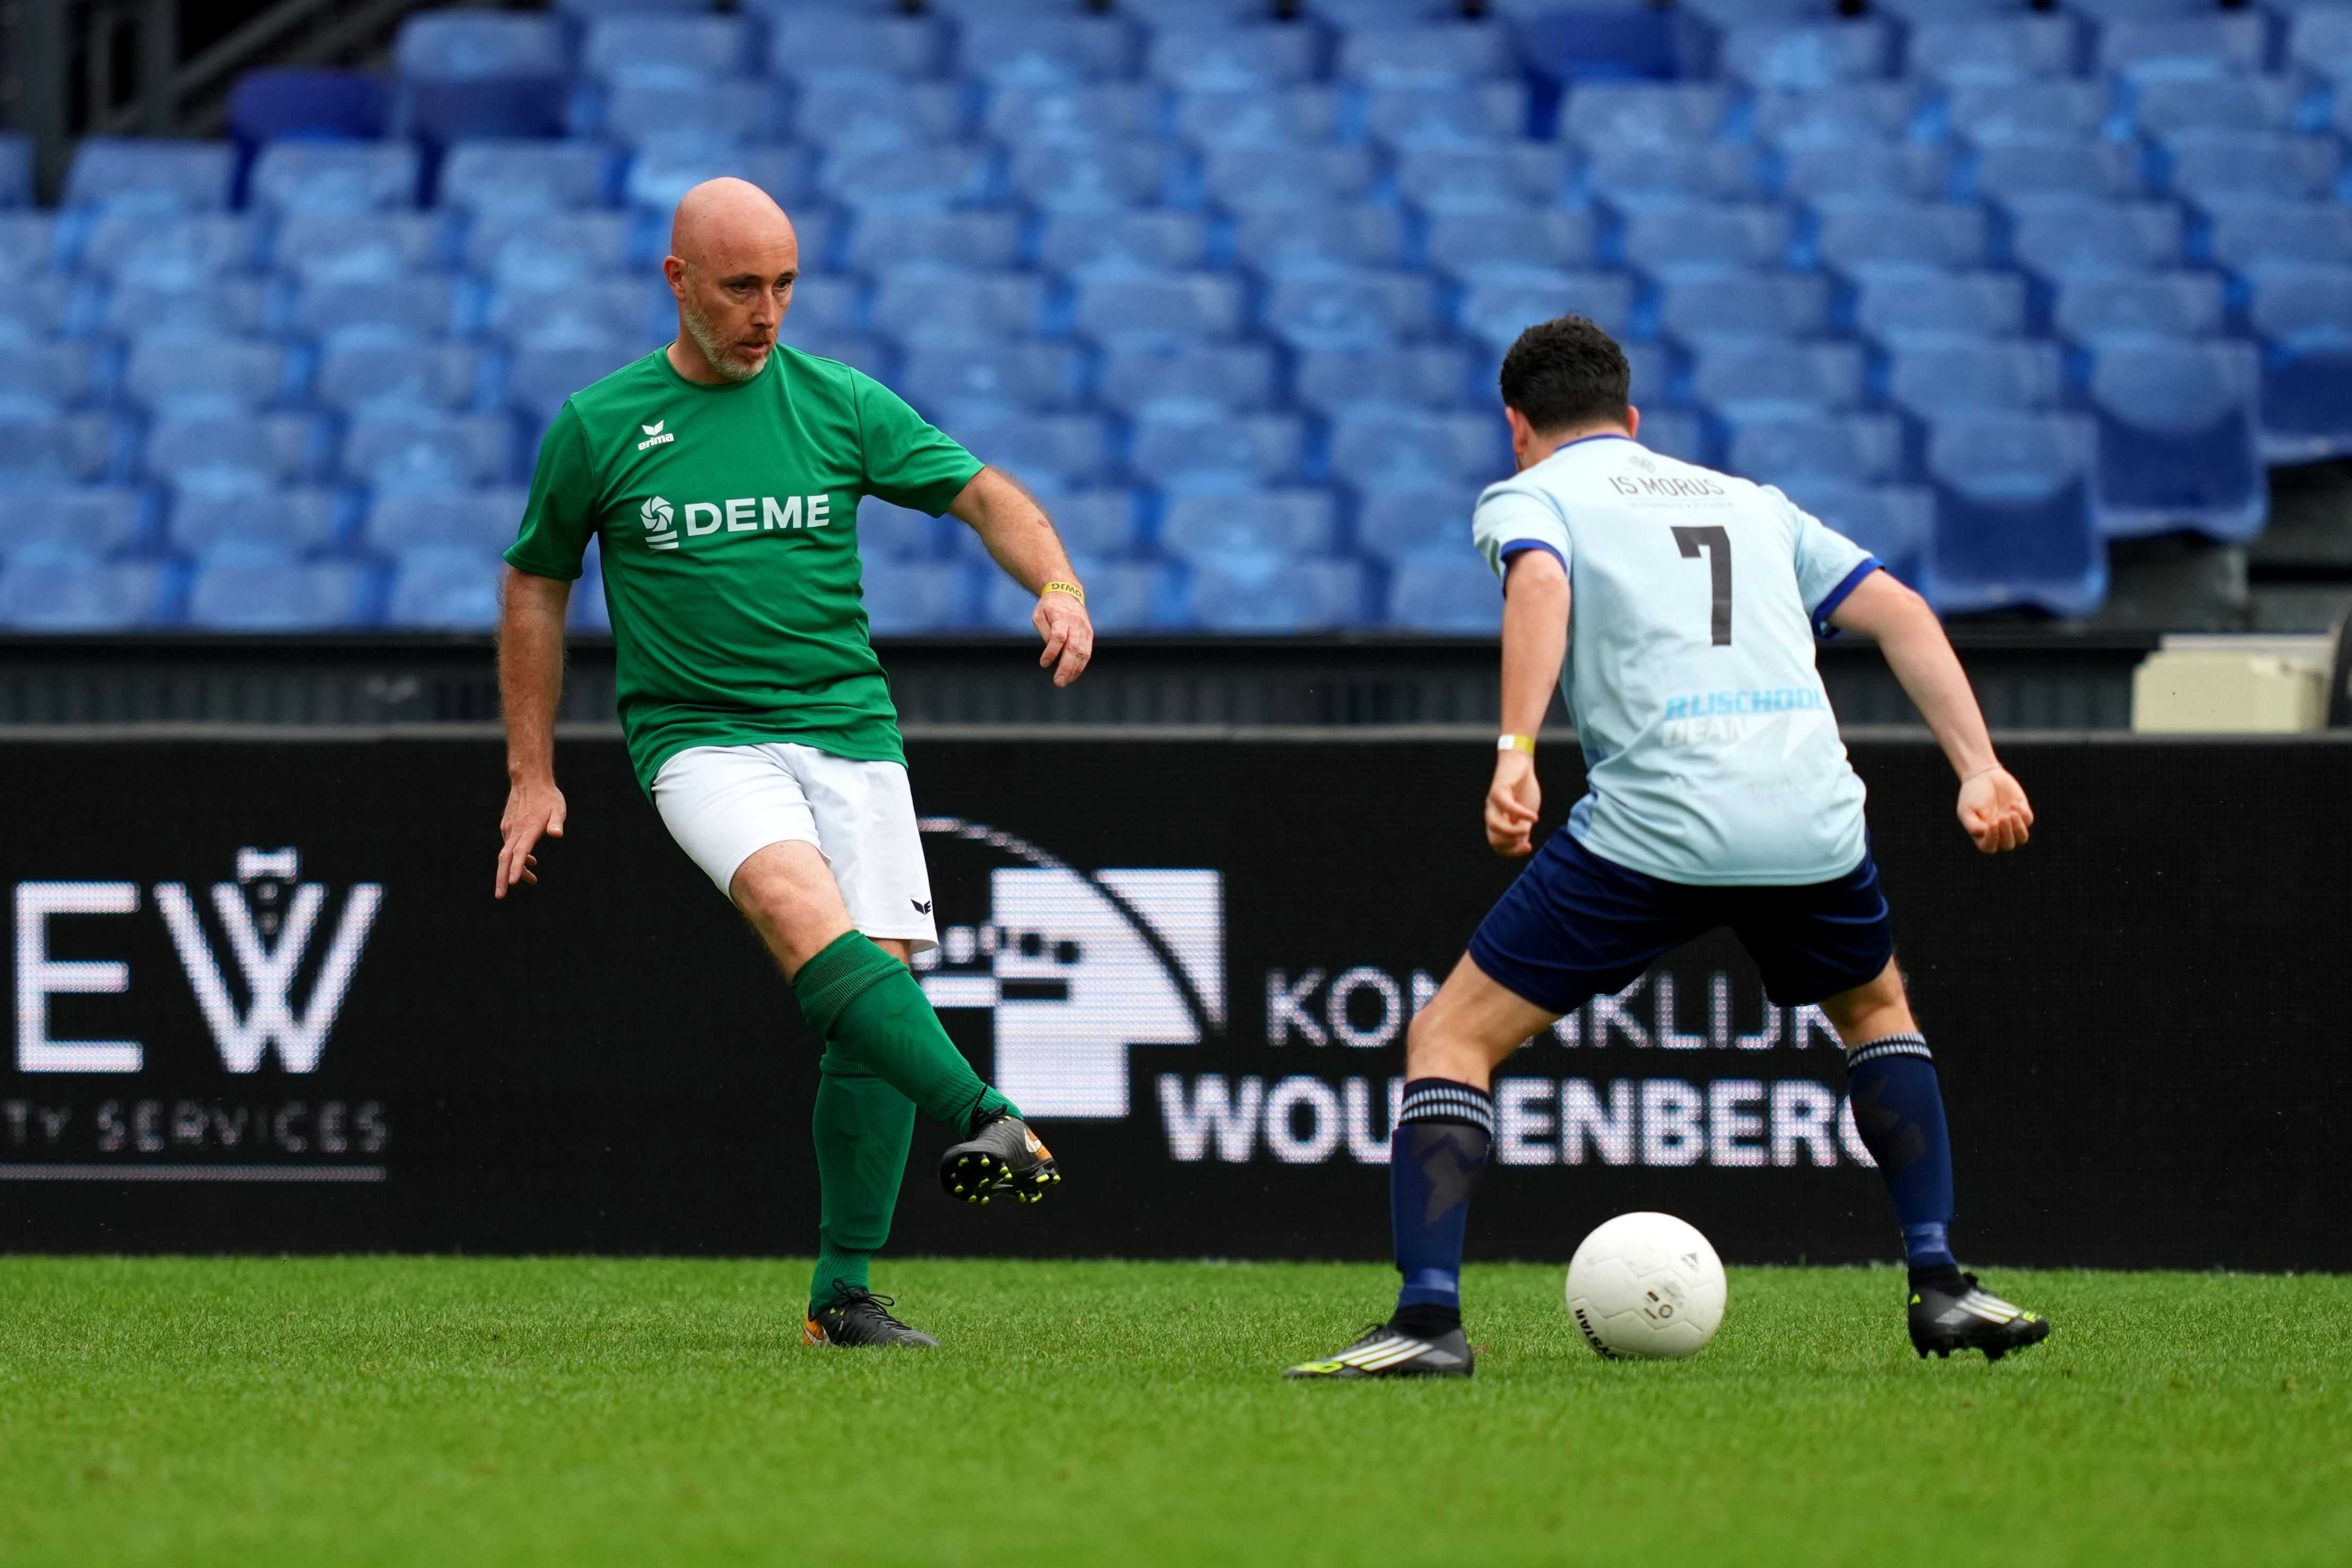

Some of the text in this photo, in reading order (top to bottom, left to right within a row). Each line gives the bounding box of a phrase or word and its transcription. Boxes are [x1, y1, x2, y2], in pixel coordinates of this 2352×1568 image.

[638, 433, 674, 451] erima
[1608, 476, 1726, 496] IS MORUS
[684, 494, 829, 536] DEME
[1670, 525, 1732, 647] 7
[97, 1099, 390, 1152] SERVICES
